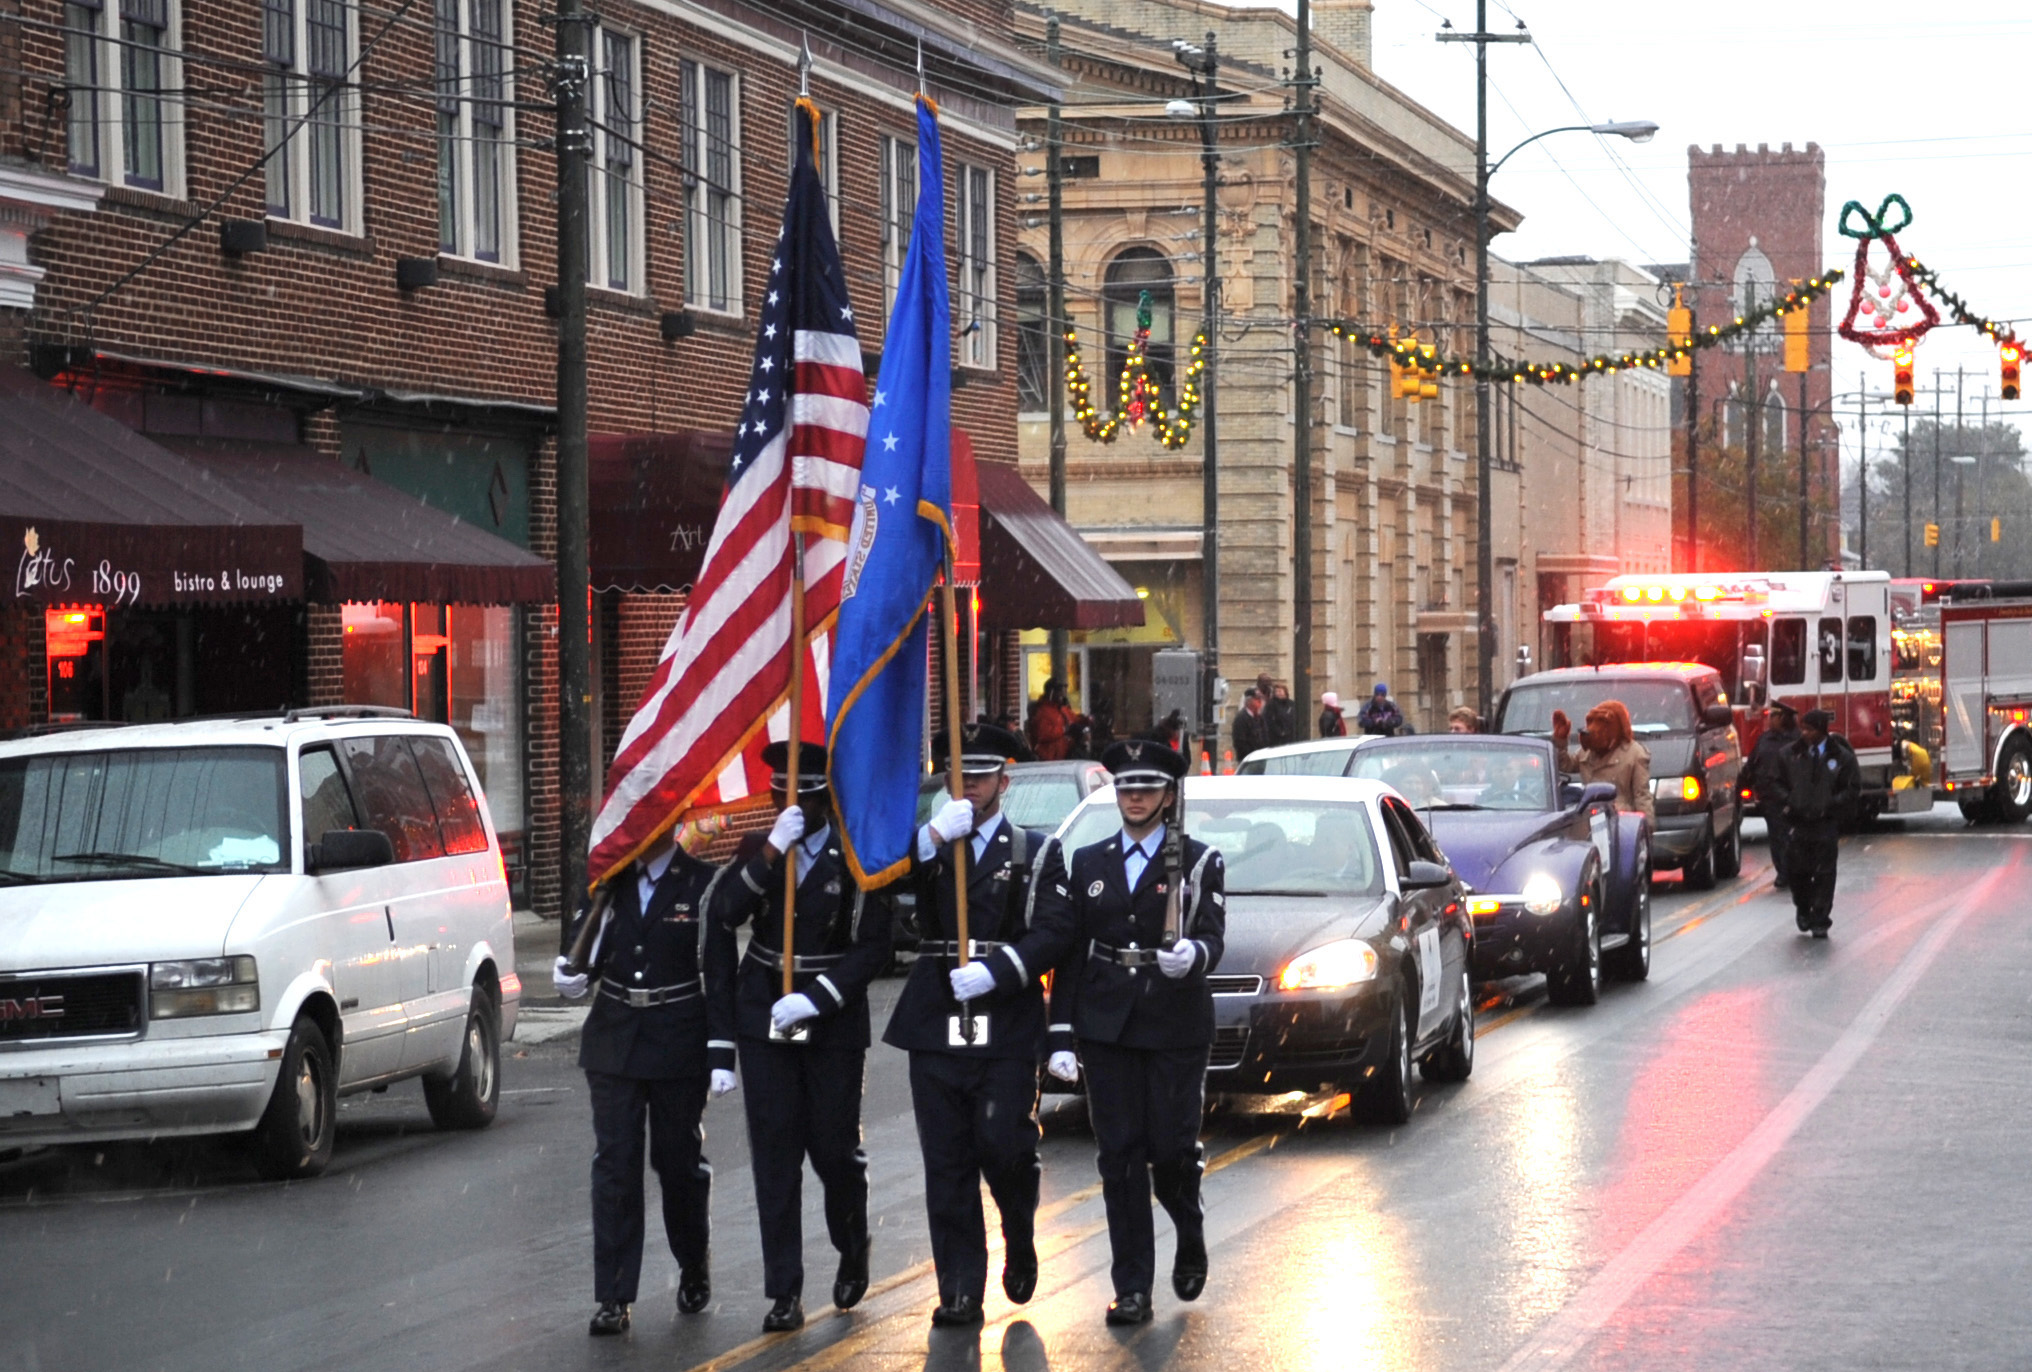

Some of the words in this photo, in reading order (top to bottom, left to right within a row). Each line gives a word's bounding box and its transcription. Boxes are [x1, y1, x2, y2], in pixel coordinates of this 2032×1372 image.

[93, 558, 141, 606] 1899
[174, 570, 215, 592] bistro
[221, 571, 231, 591] &
[236, 568, 284, 594] lounge
[1825, 632, 1836, 664] 3
[0, 995, 65, 1020] MC
